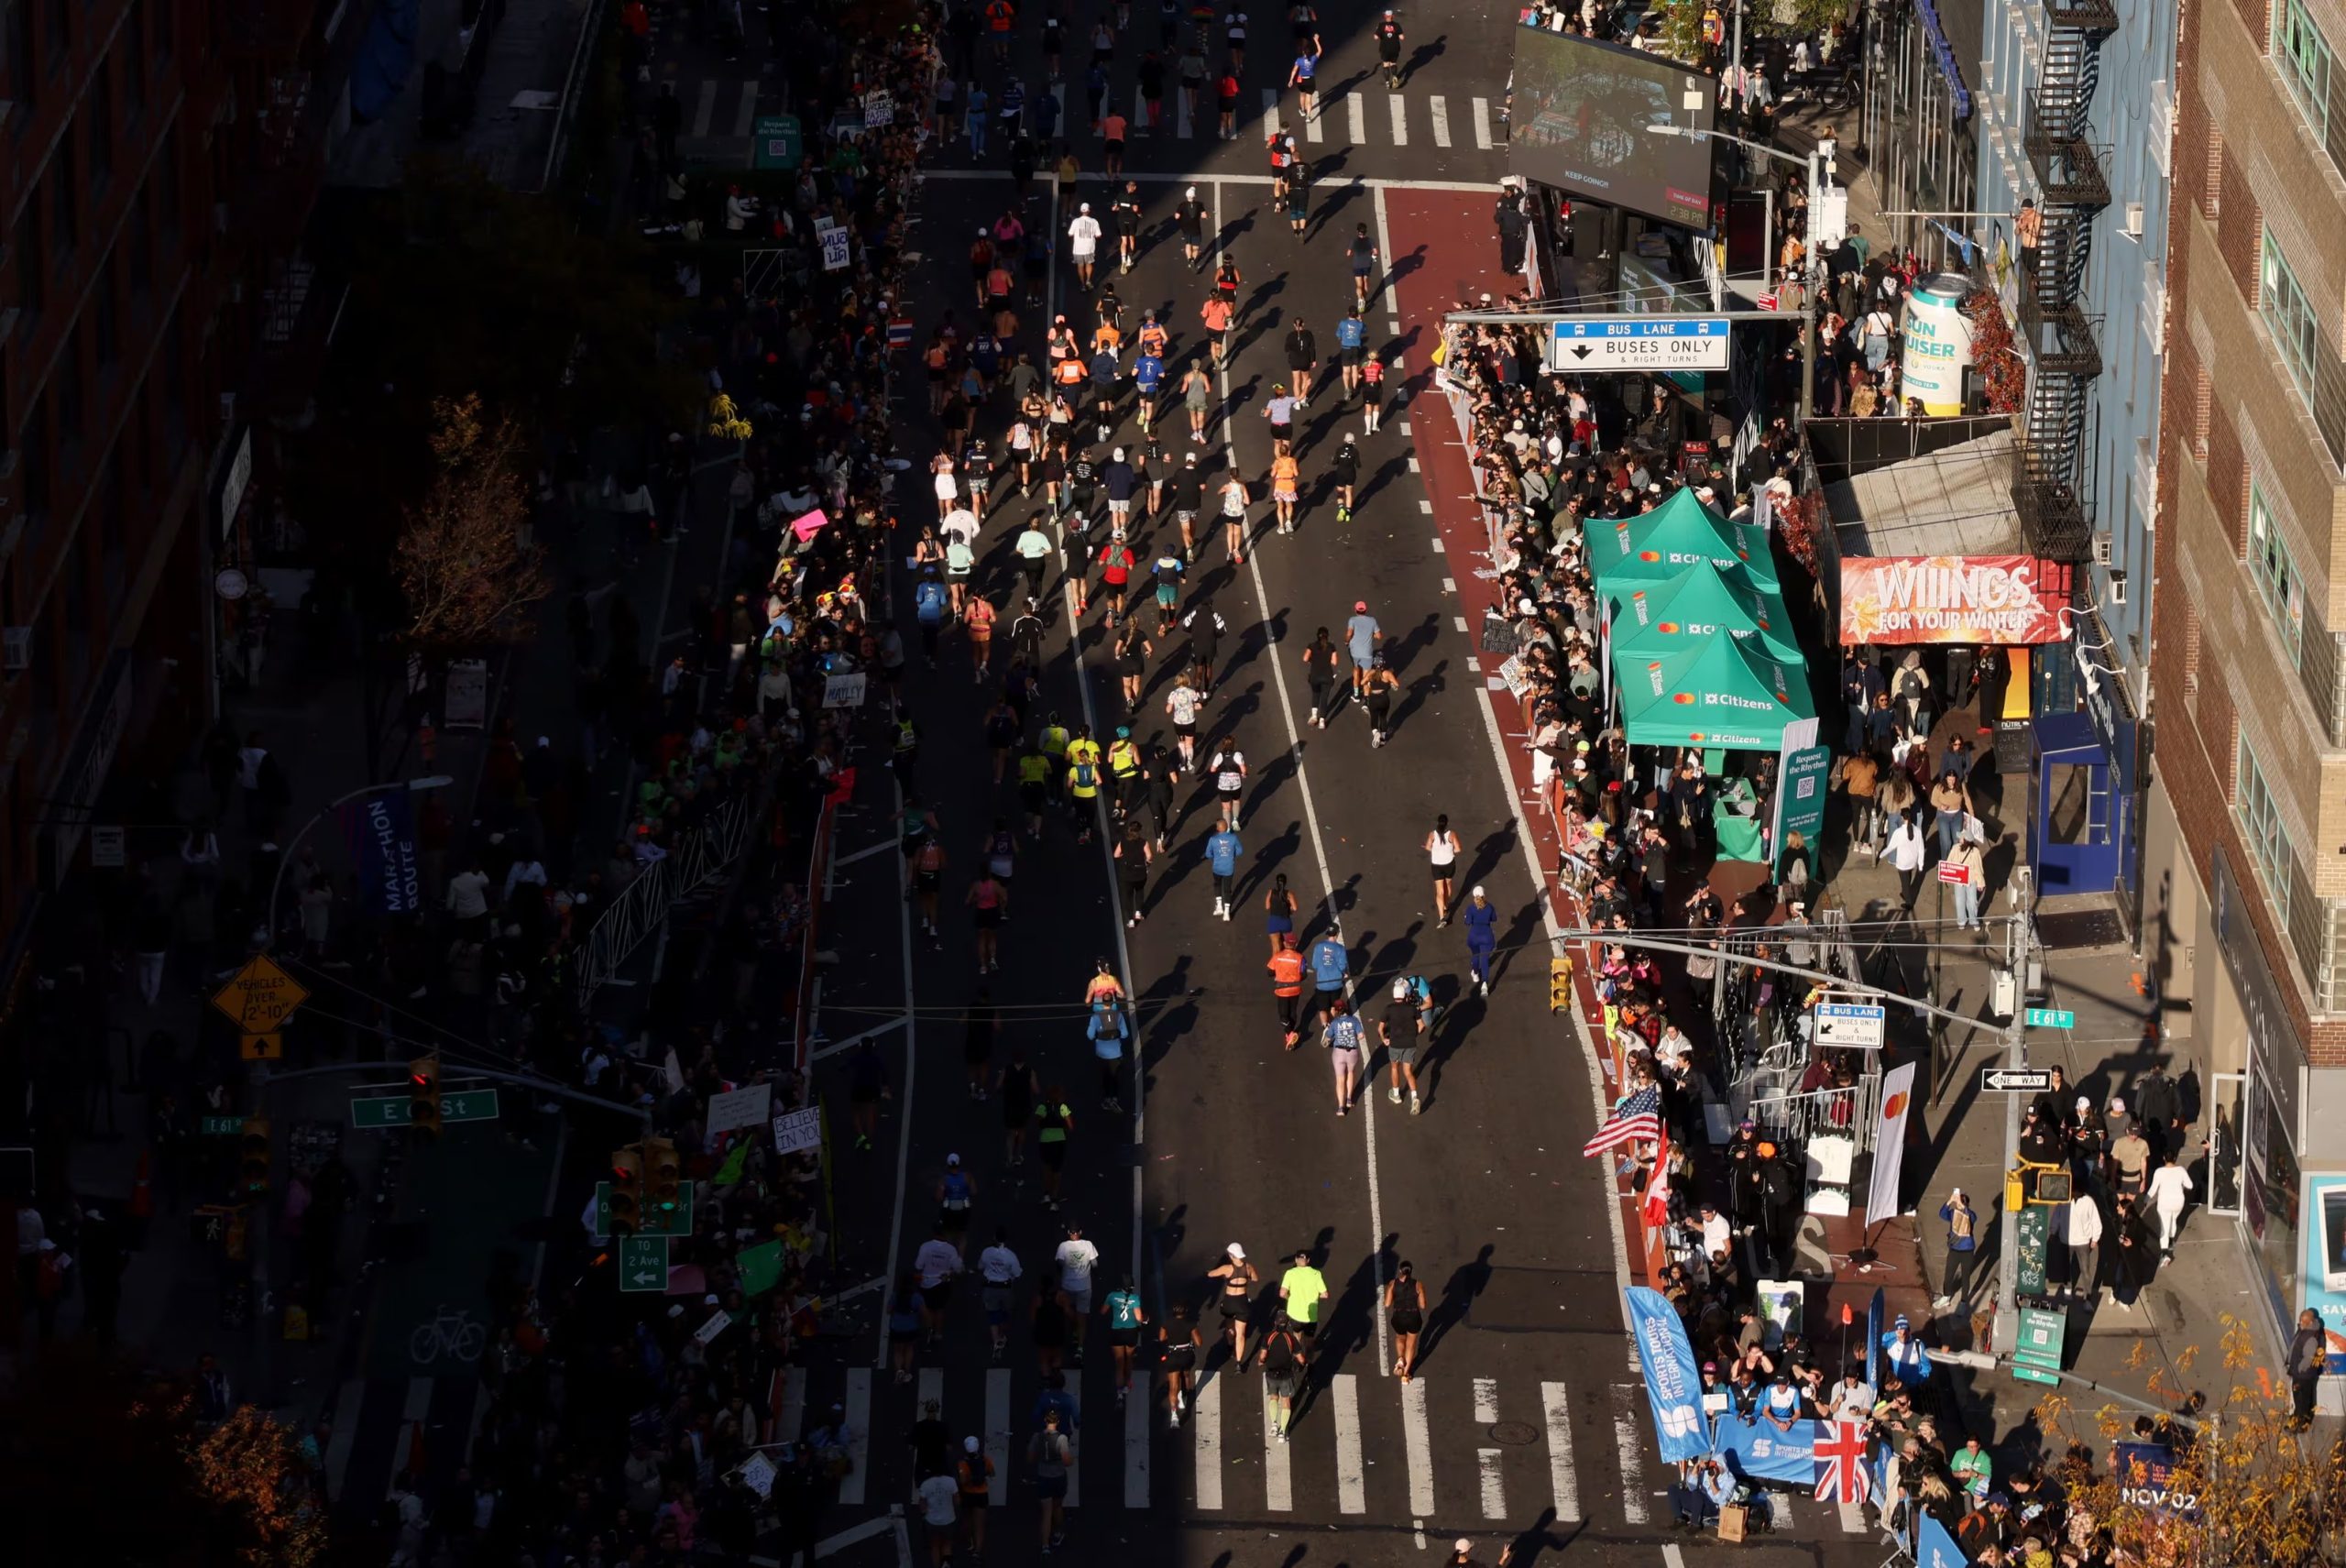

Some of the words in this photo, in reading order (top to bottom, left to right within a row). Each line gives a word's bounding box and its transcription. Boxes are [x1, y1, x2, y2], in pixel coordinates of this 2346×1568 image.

[1565, 170, 1583, 181] KEEP
[1692, 212, 1704, 224] PM
[1608, 324, 1631, 335] BUS
[1643, 324, 1675, 334] LANE
[1906, 314, 1935, 337] SUN
[1606, 341, 1659, 354] BUSES
[1671, 340, 1712, 353] ONLY
[1874, 566, 2031, 609] WIIINGS
[1880, 612, 1911, 630] FOR
[1917, 612, 1962, 630] YOUR
[1964, 611, 2028, 630] WINTER
[1720, 694, 1772, 710] Citizens
[1722, 734, 1760, 744] Citizens
[1796, 752, 1822, 764] Request
[1789, 764, 1801, 775] the
[1801, 761, 1826, 773] Rhythm
[367, 799, 402, 912] MARATHON
[400, 840, 419, 910] ROUTE
[236, 977, 286, 991] VEHICLES
[247, 992, 276, 1003] OVER
[1834, 1007, 1851, 1015] BUS
[2034, 1011, 2040, 1024] E
[2044, 1013, 2055, 1025] 61
[2058, 1014, 2066, 1022] St
[1857, 1036, 1878, 1044] TURNS
[1993, 1076, 2012, 1085] ONE
[2022, 1077, 2042, 1085] WAY
[384, 1102, 398, 1120] E
[440, 1099, 466, 1115] St
[778, 1135, 797, 1150] IN
[638, 1241, 651, 1251] TO
[629, 1255, 637, 1266] 2
[640, 1256, 660, 1266] Ave
[2033, 1311, 2054, 1321] Request
[2035, 1320, 2057, 1328] Rhythm
[1646, 1317, 1662, 1355] TOURS
[1653, 1356, 1673, 1400] SPORTS
[1775, 1444, 1801, 1453] SPORTS
[2121, 1486, 2166, 1505] NOV
[2171, 1493, 2197, 1510] 02
